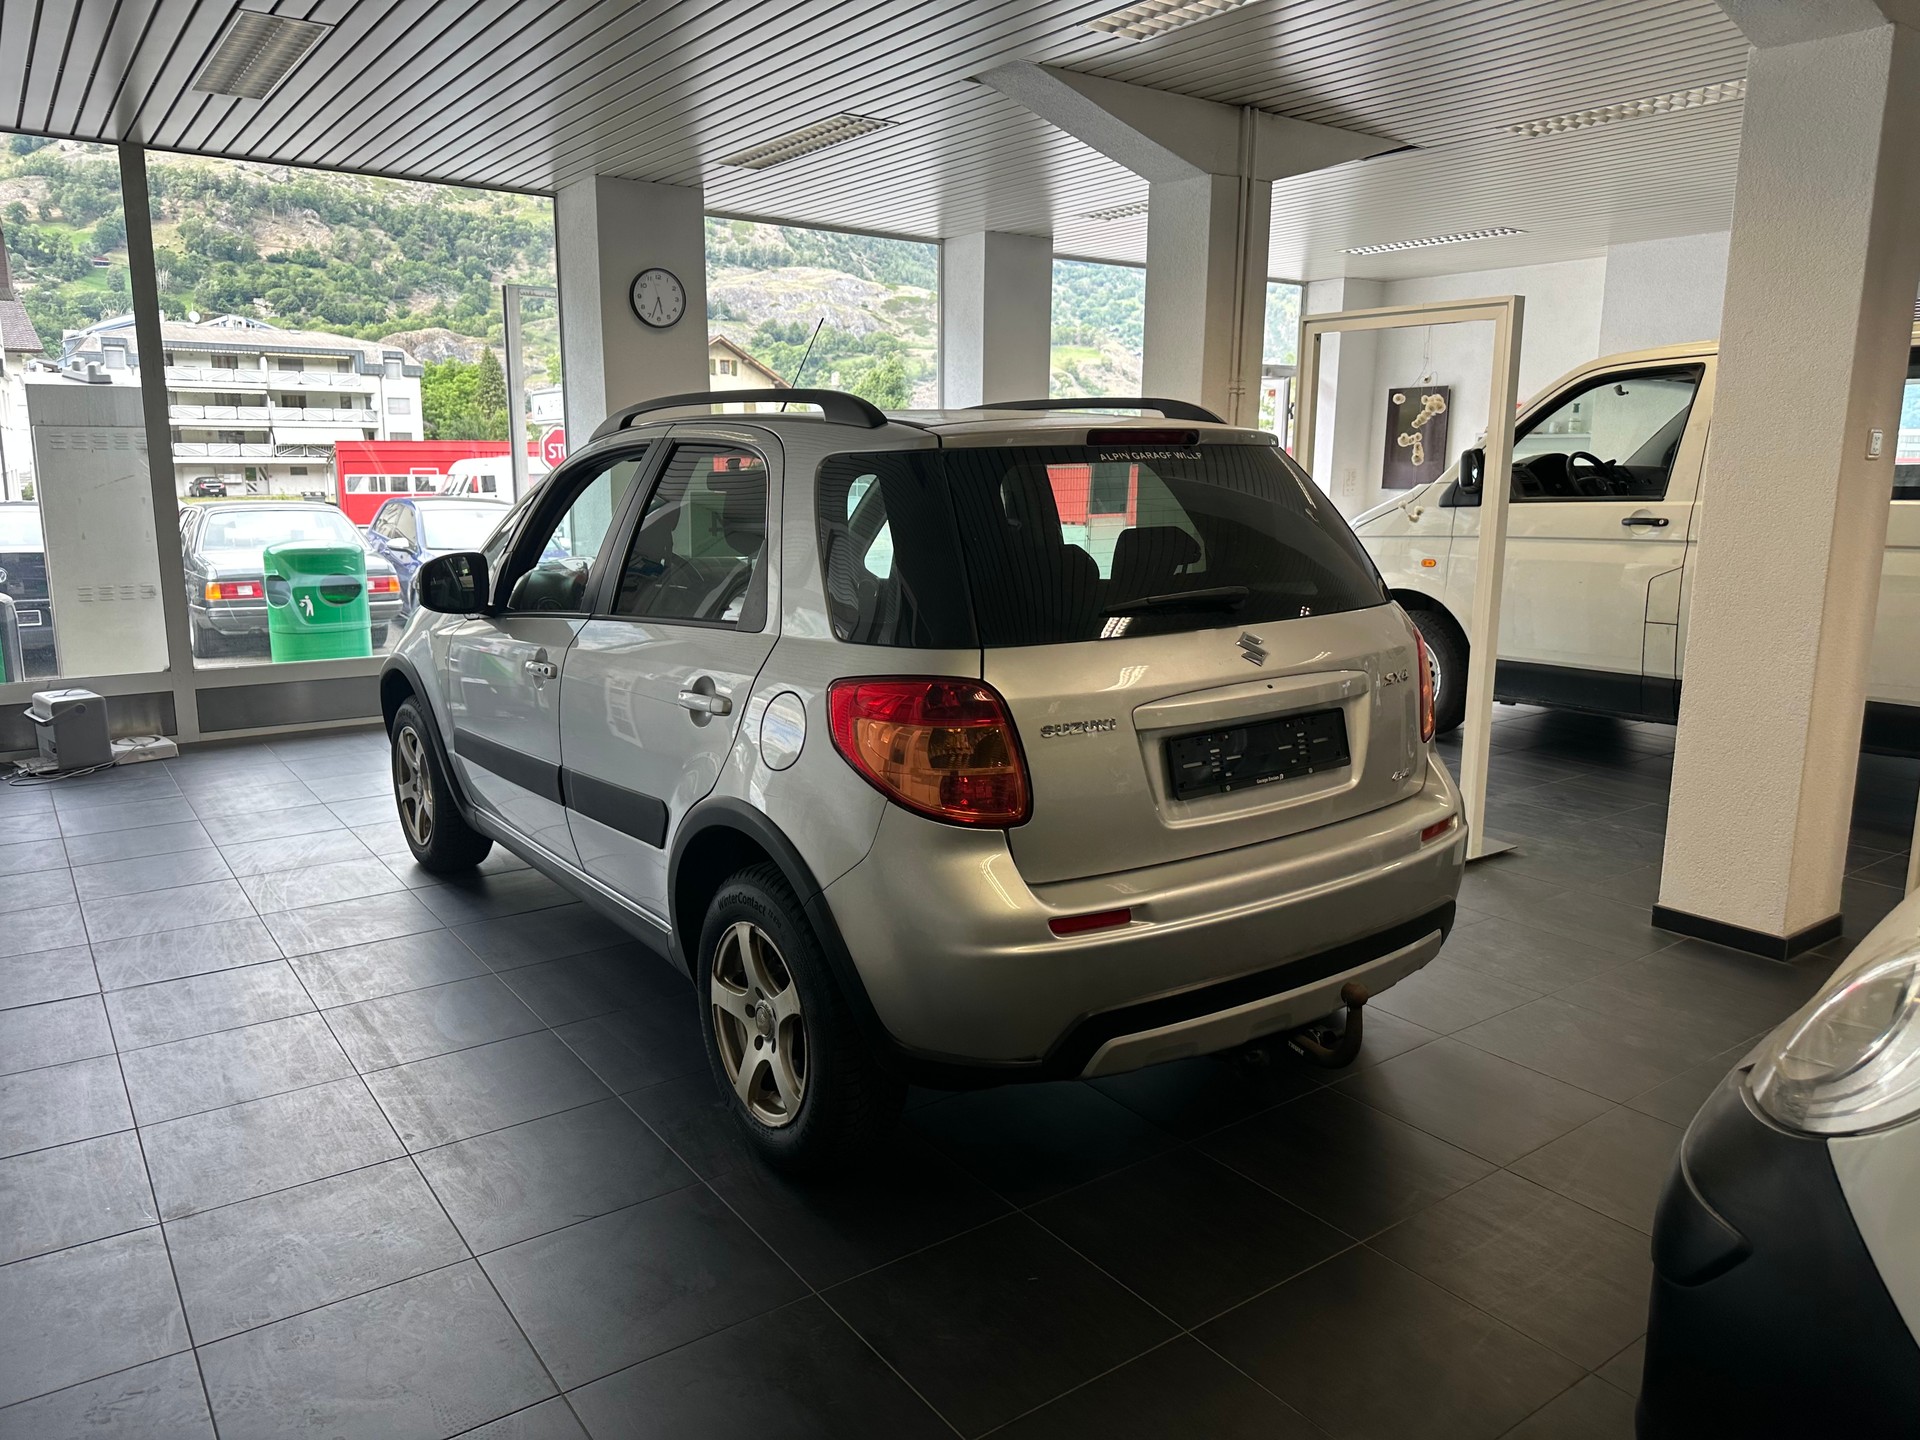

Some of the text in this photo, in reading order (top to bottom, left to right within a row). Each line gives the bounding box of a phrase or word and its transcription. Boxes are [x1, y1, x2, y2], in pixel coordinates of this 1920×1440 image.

[1383, 669, 1409, 687] SX4
[1041, 718, 1116, 739] SUZUKI
[717, 892, 766, 916] WinterContact
